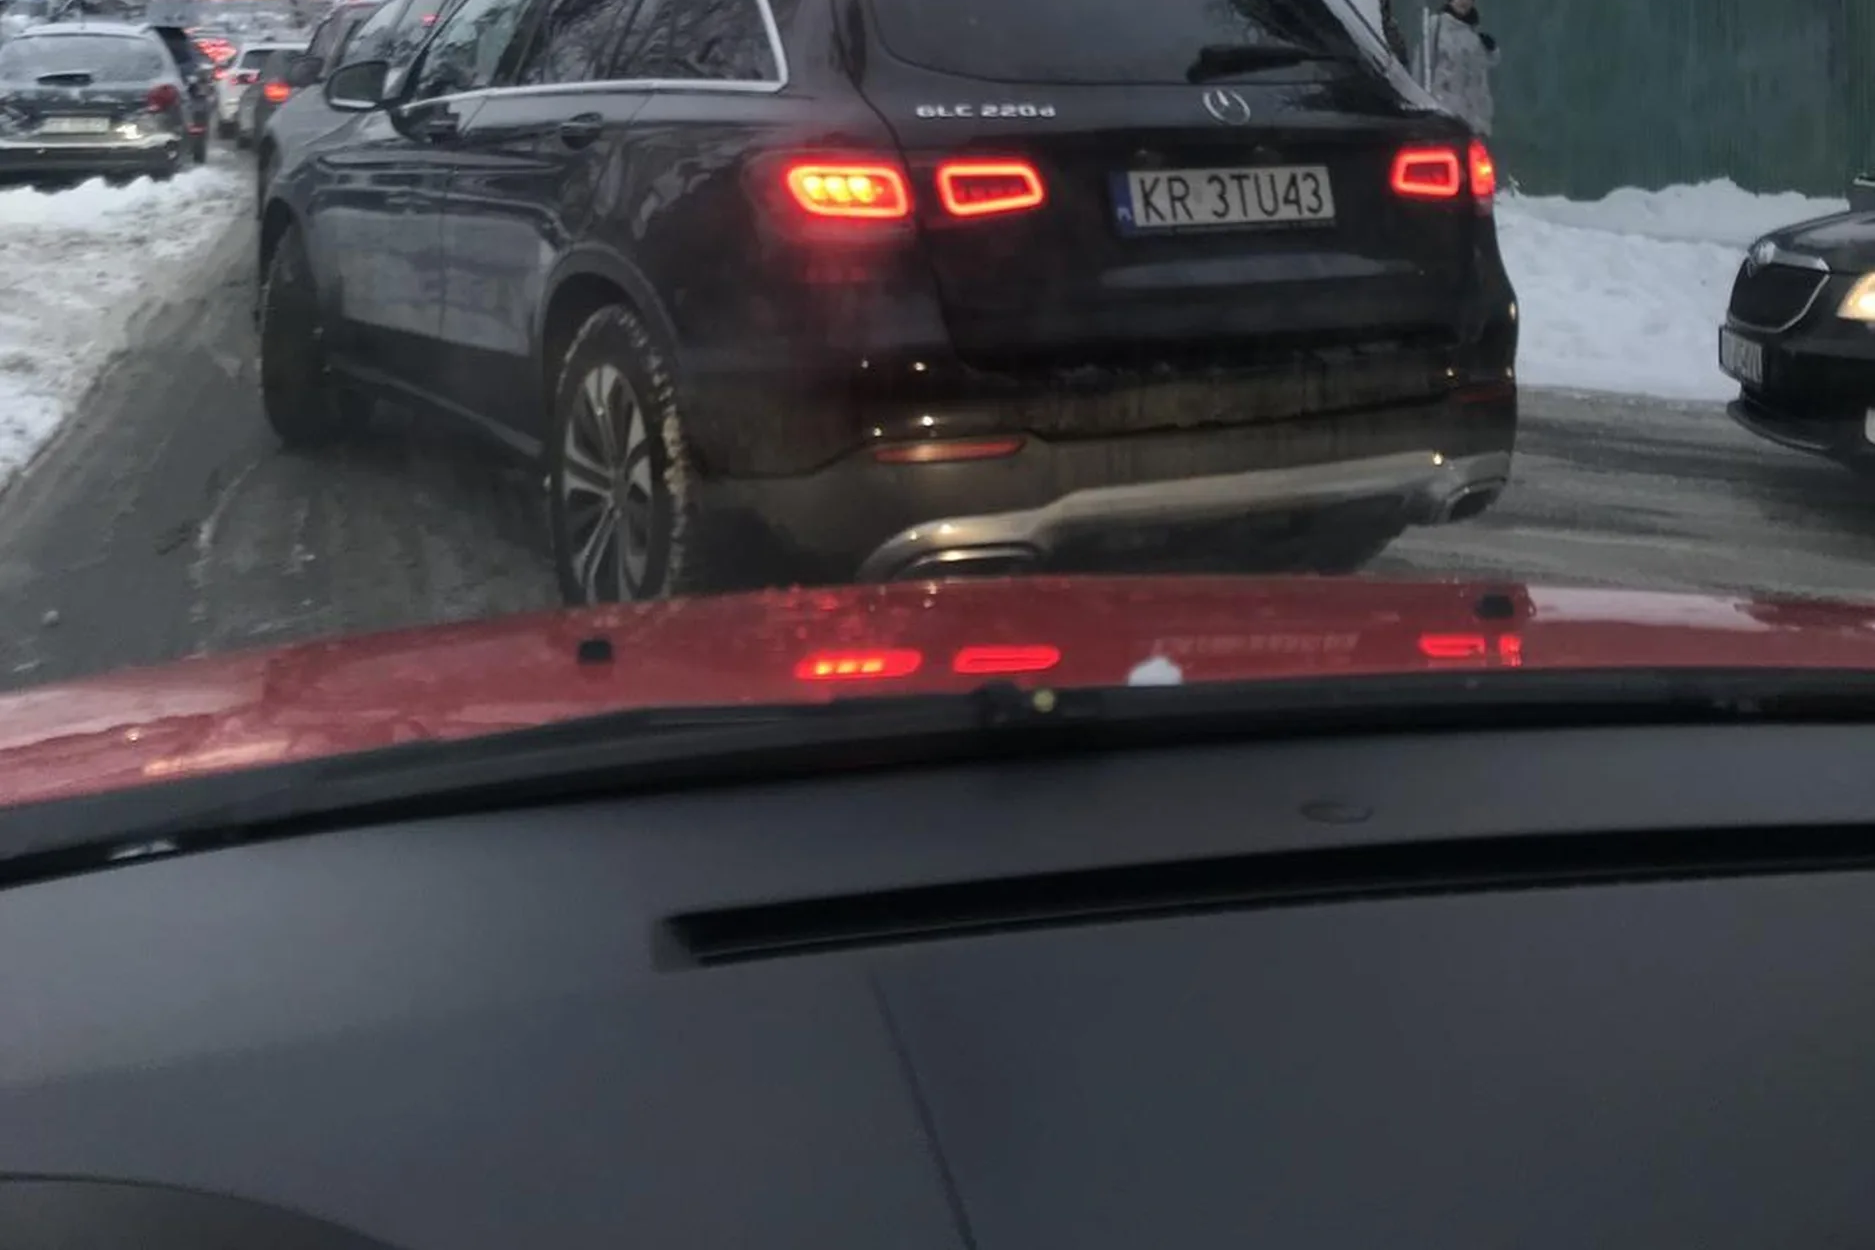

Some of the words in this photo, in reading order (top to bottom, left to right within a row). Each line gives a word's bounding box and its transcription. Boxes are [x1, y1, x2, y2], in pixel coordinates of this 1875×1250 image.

[916, 103, 974, 118] GLC
[981, 103, 1056, 118] 220d
[1139, 175, 1194, 223] KR
[1206, 171, 1324, 220] 3TU43
